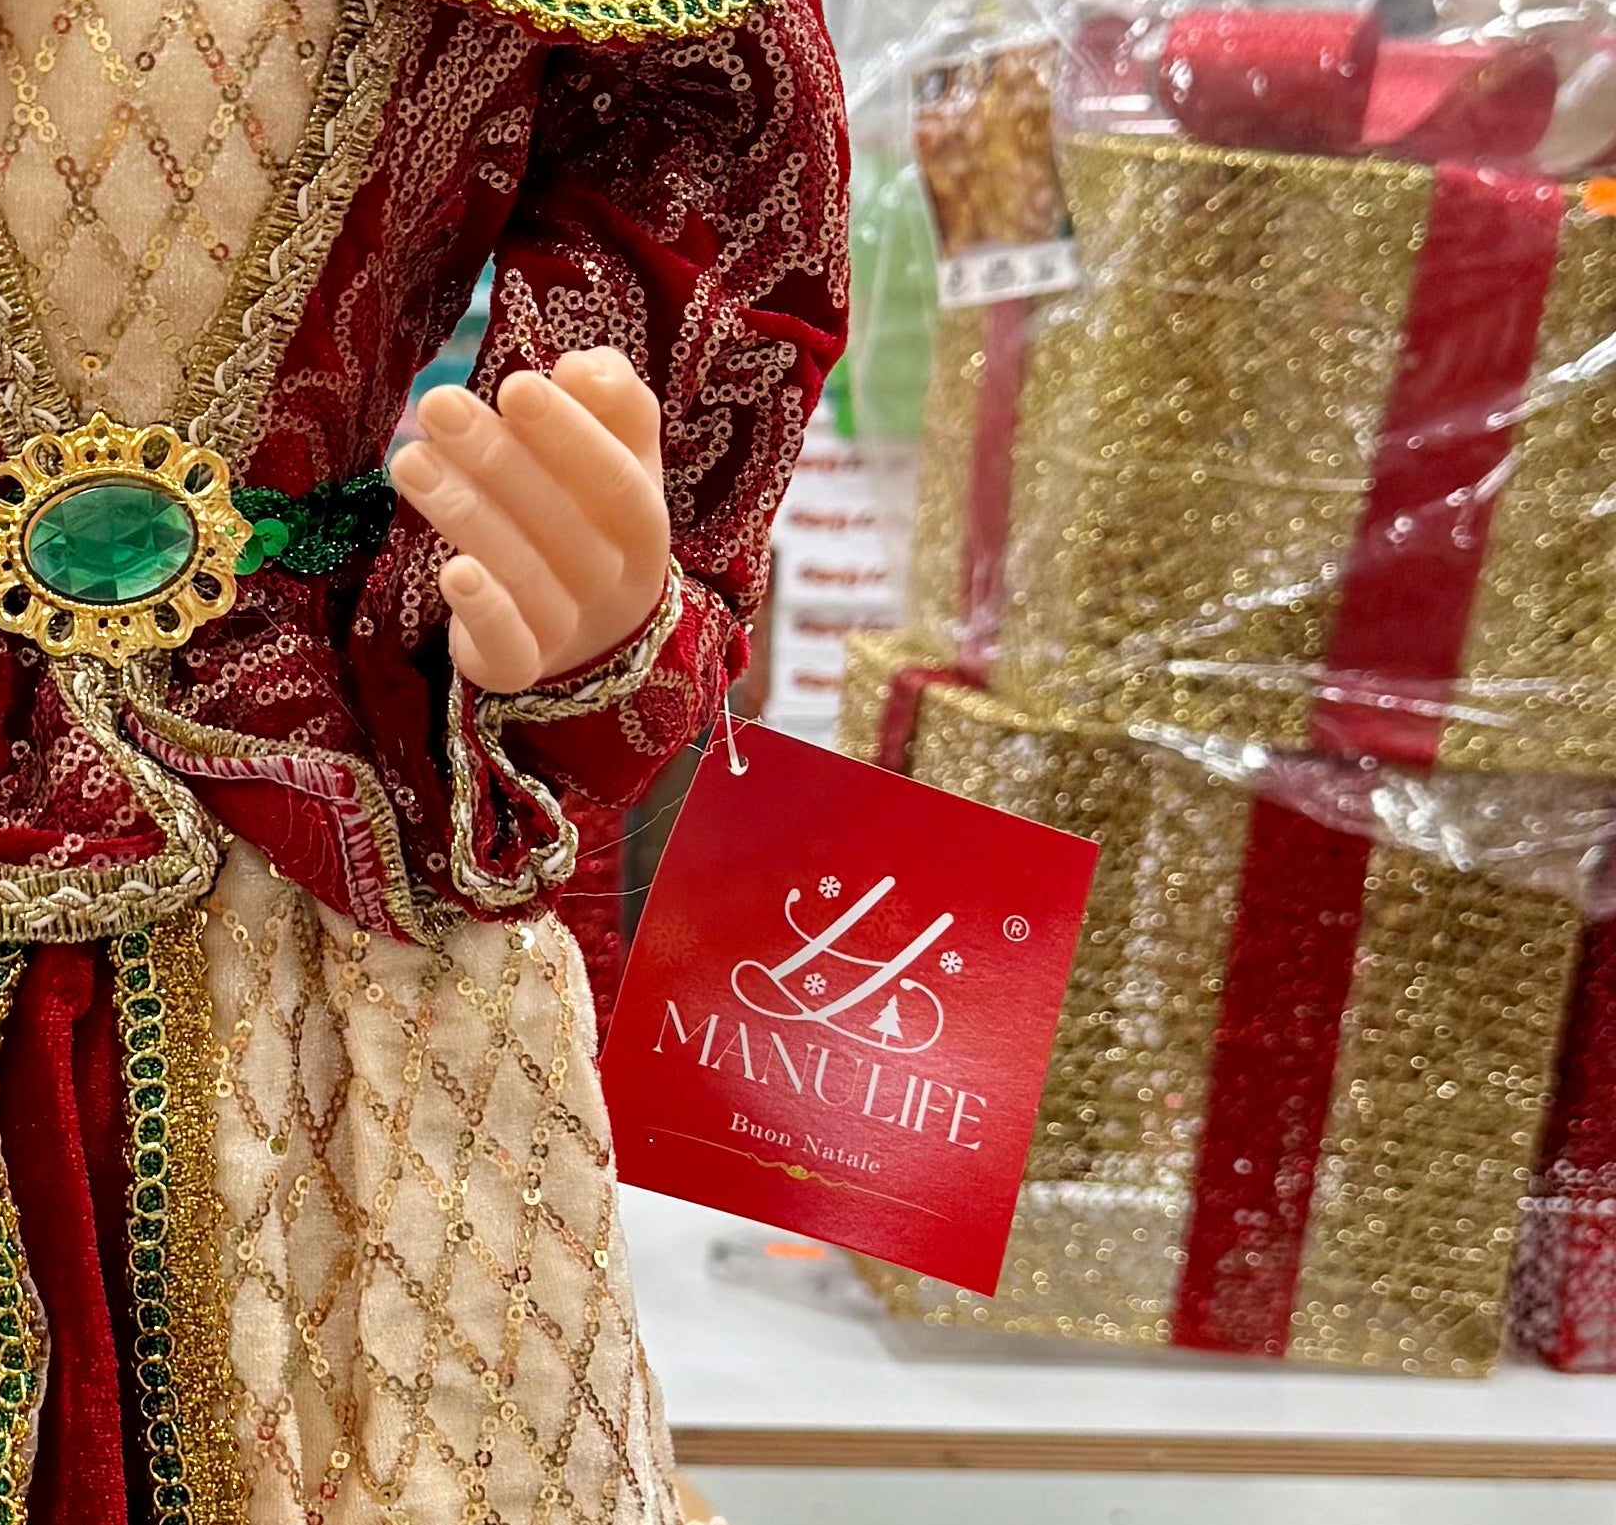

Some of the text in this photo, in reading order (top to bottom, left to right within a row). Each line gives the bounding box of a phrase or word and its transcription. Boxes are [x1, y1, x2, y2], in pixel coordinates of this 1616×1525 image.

[652, 1000, 987, 1150] MANULIFE
[728, 1112, 882, 1175] Buon Natale
